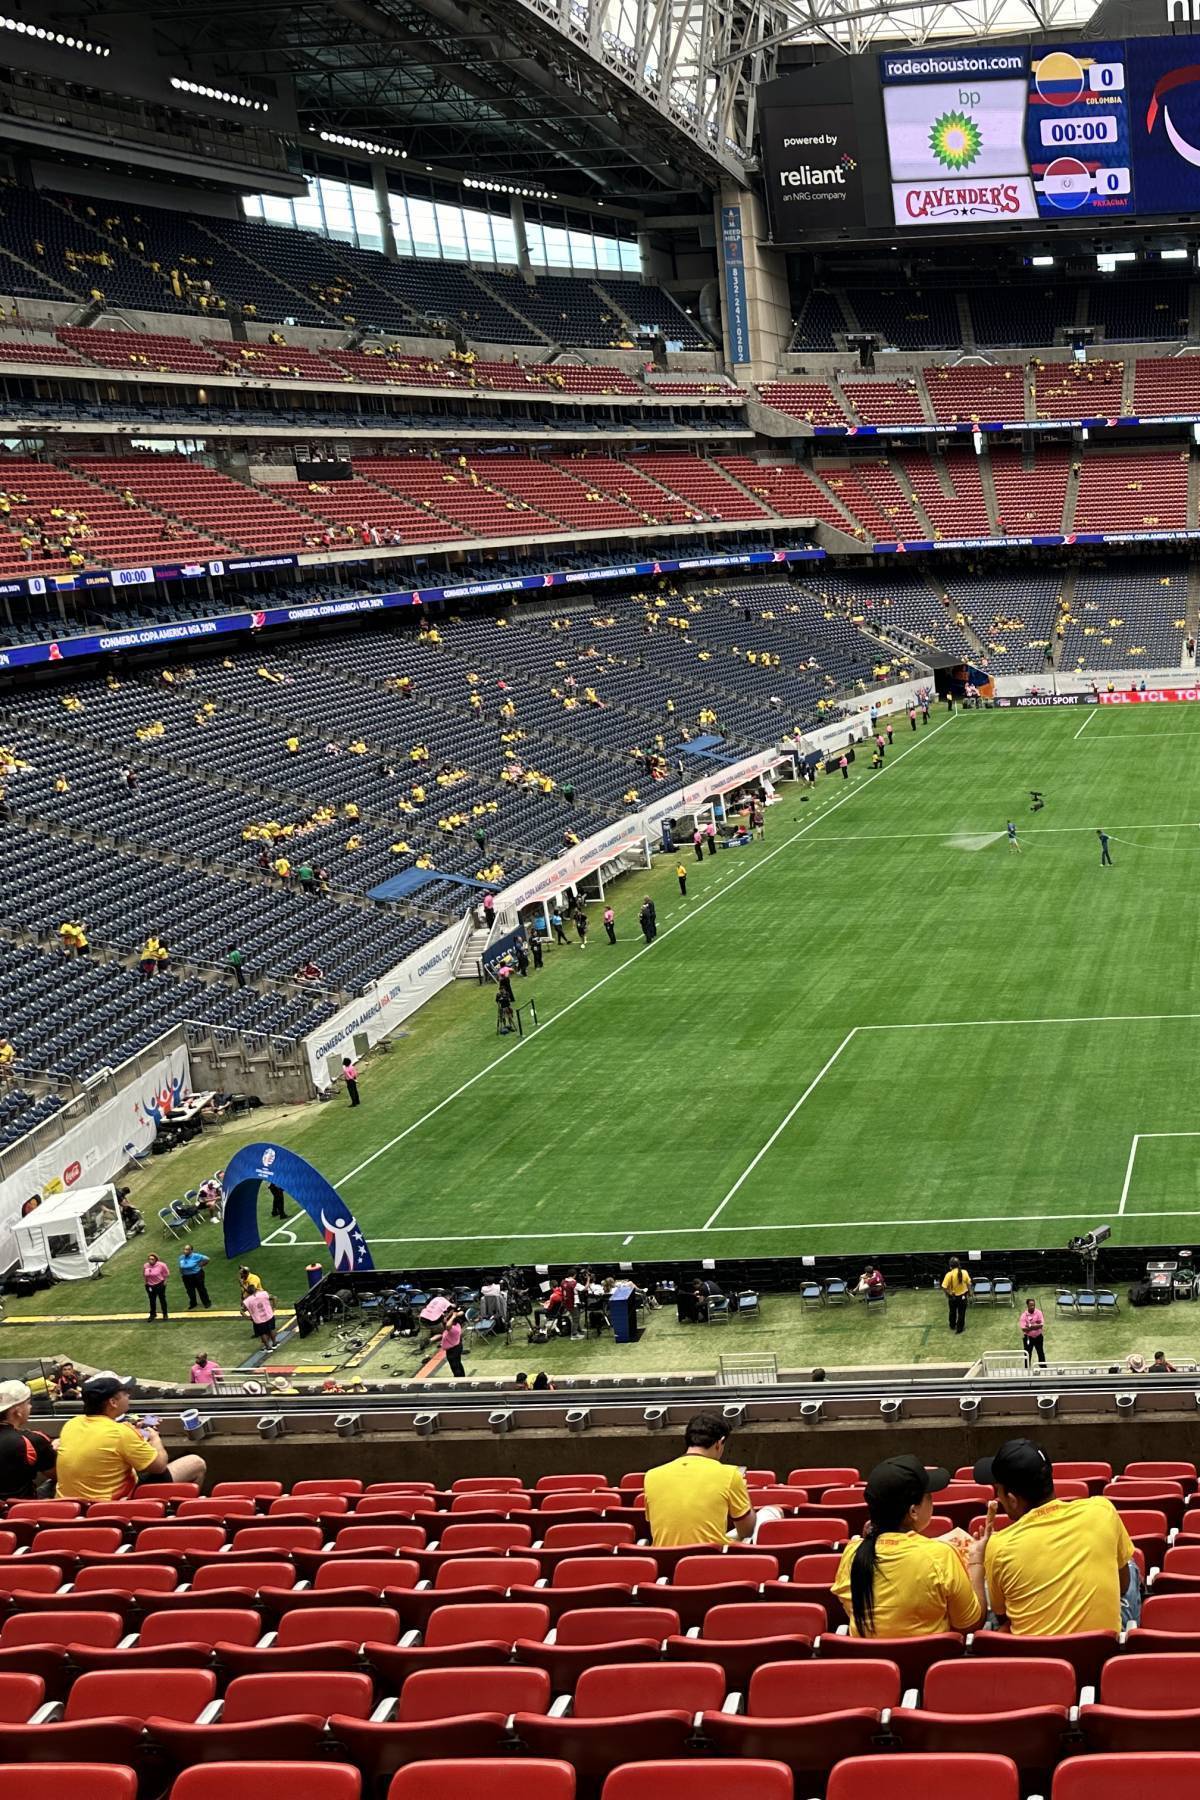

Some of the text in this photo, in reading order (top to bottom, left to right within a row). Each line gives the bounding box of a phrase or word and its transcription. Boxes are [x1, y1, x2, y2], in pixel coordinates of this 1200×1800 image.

[888, 56, 1022, 75] rodeohouston.com
[1101, 69, 1113, 86] 0
[958, 89, 981, 108] bp
[1086, 96, 1122, 105] COLOMBIA
[1052, 122, 1108, 142] 00:00
[784, 134, 838, 148] powered by
[780, 165, 846, 186] reliant
[1107, 174, 1119, 190] 0
[793, 192, 811, 200] NRG
[812, 191, 847, 200] company
[906, 184, 1020, 218] CAVENDER'S
[213, 562, 220, 574] 0
[34, 579, 42, 592] 0
[120, 571, 147, 584] 00:00
[100, 633, 140, 649] CONMEBOL
[140, 631, 159, 643] COPA
[160, 626, 188, 640] AMERICA
[1016, 698, 1051, 706] ABSOLUT
[1053, 696, 1079, 704] SPORT
[1102, 694, 1131, 703] TCL
[1138, 692, 1168, 701] TCL
[418, 953, 442, 976] CONMEBOL
[316, 1032, 344, 1059] CONMEBOL
[345, 1019, 359, 1036] COPA
[360, 1004, 381, 1025] AMERICA
